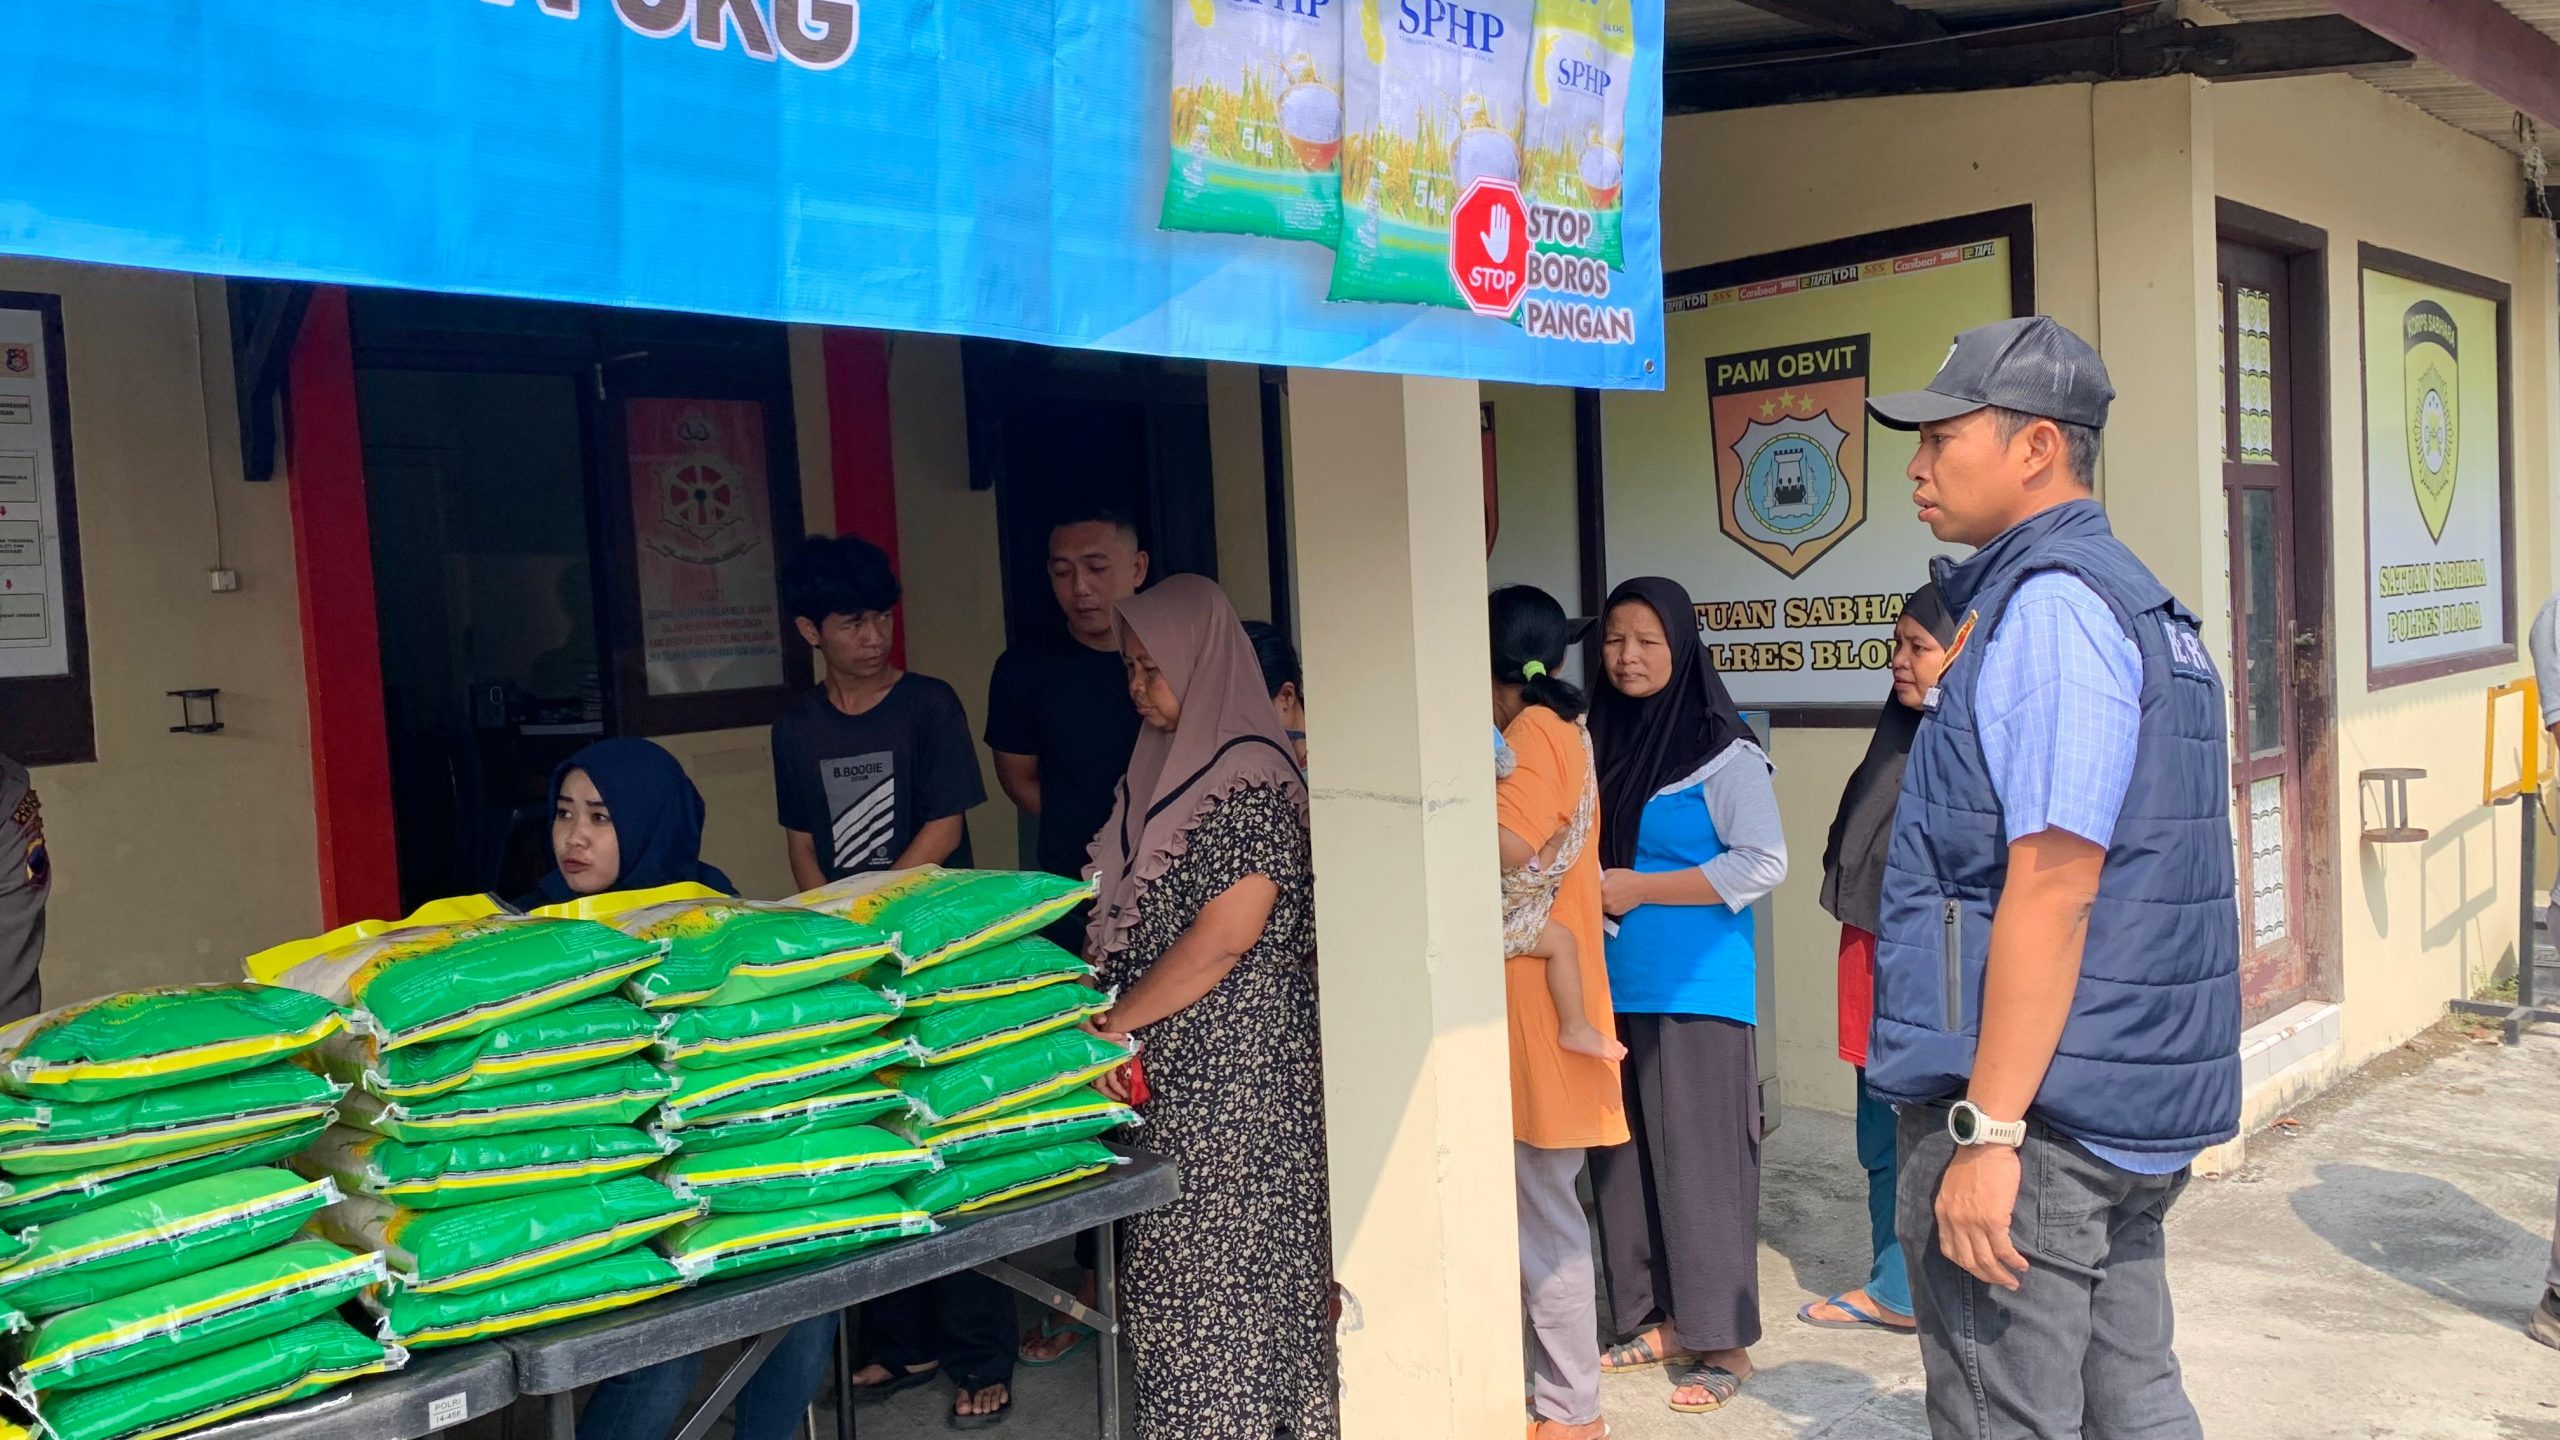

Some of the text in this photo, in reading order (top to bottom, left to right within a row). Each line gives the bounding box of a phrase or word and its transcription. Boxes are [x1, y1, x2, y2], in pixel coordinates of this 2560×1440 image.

[1398, 0, 1505, 53] SPHP
[1558, 58, 1611, 97] SPHP
[1528, 205, 1592, 247] STOP
[1468, 266, 1517, 299] STOP
[1527, 253, 1608, 297] BOROS
[1833, 268, 1857, 282] TDR
[1894, 257, 1937, 272] Canibeat
[1685, 294, 1708, 308] TDR
[1740, 285, 1777, 299] Canibeat
[1527, 301, 1634, 343] PANGAN
[1717, 345, 1857, 387] PAM OBVIT
[2380, 559, 2487, 598] SATUAN SABHARA
[1783, 593, 1914, 628] SABHA
[2387, 601, 2482, 644] POLRES BLORA
[1811, 639, 1899, 670] BLO
[833, 763, 884, 778] B.BOOGIE
[434, 1397, 461, 1410] POLRI
